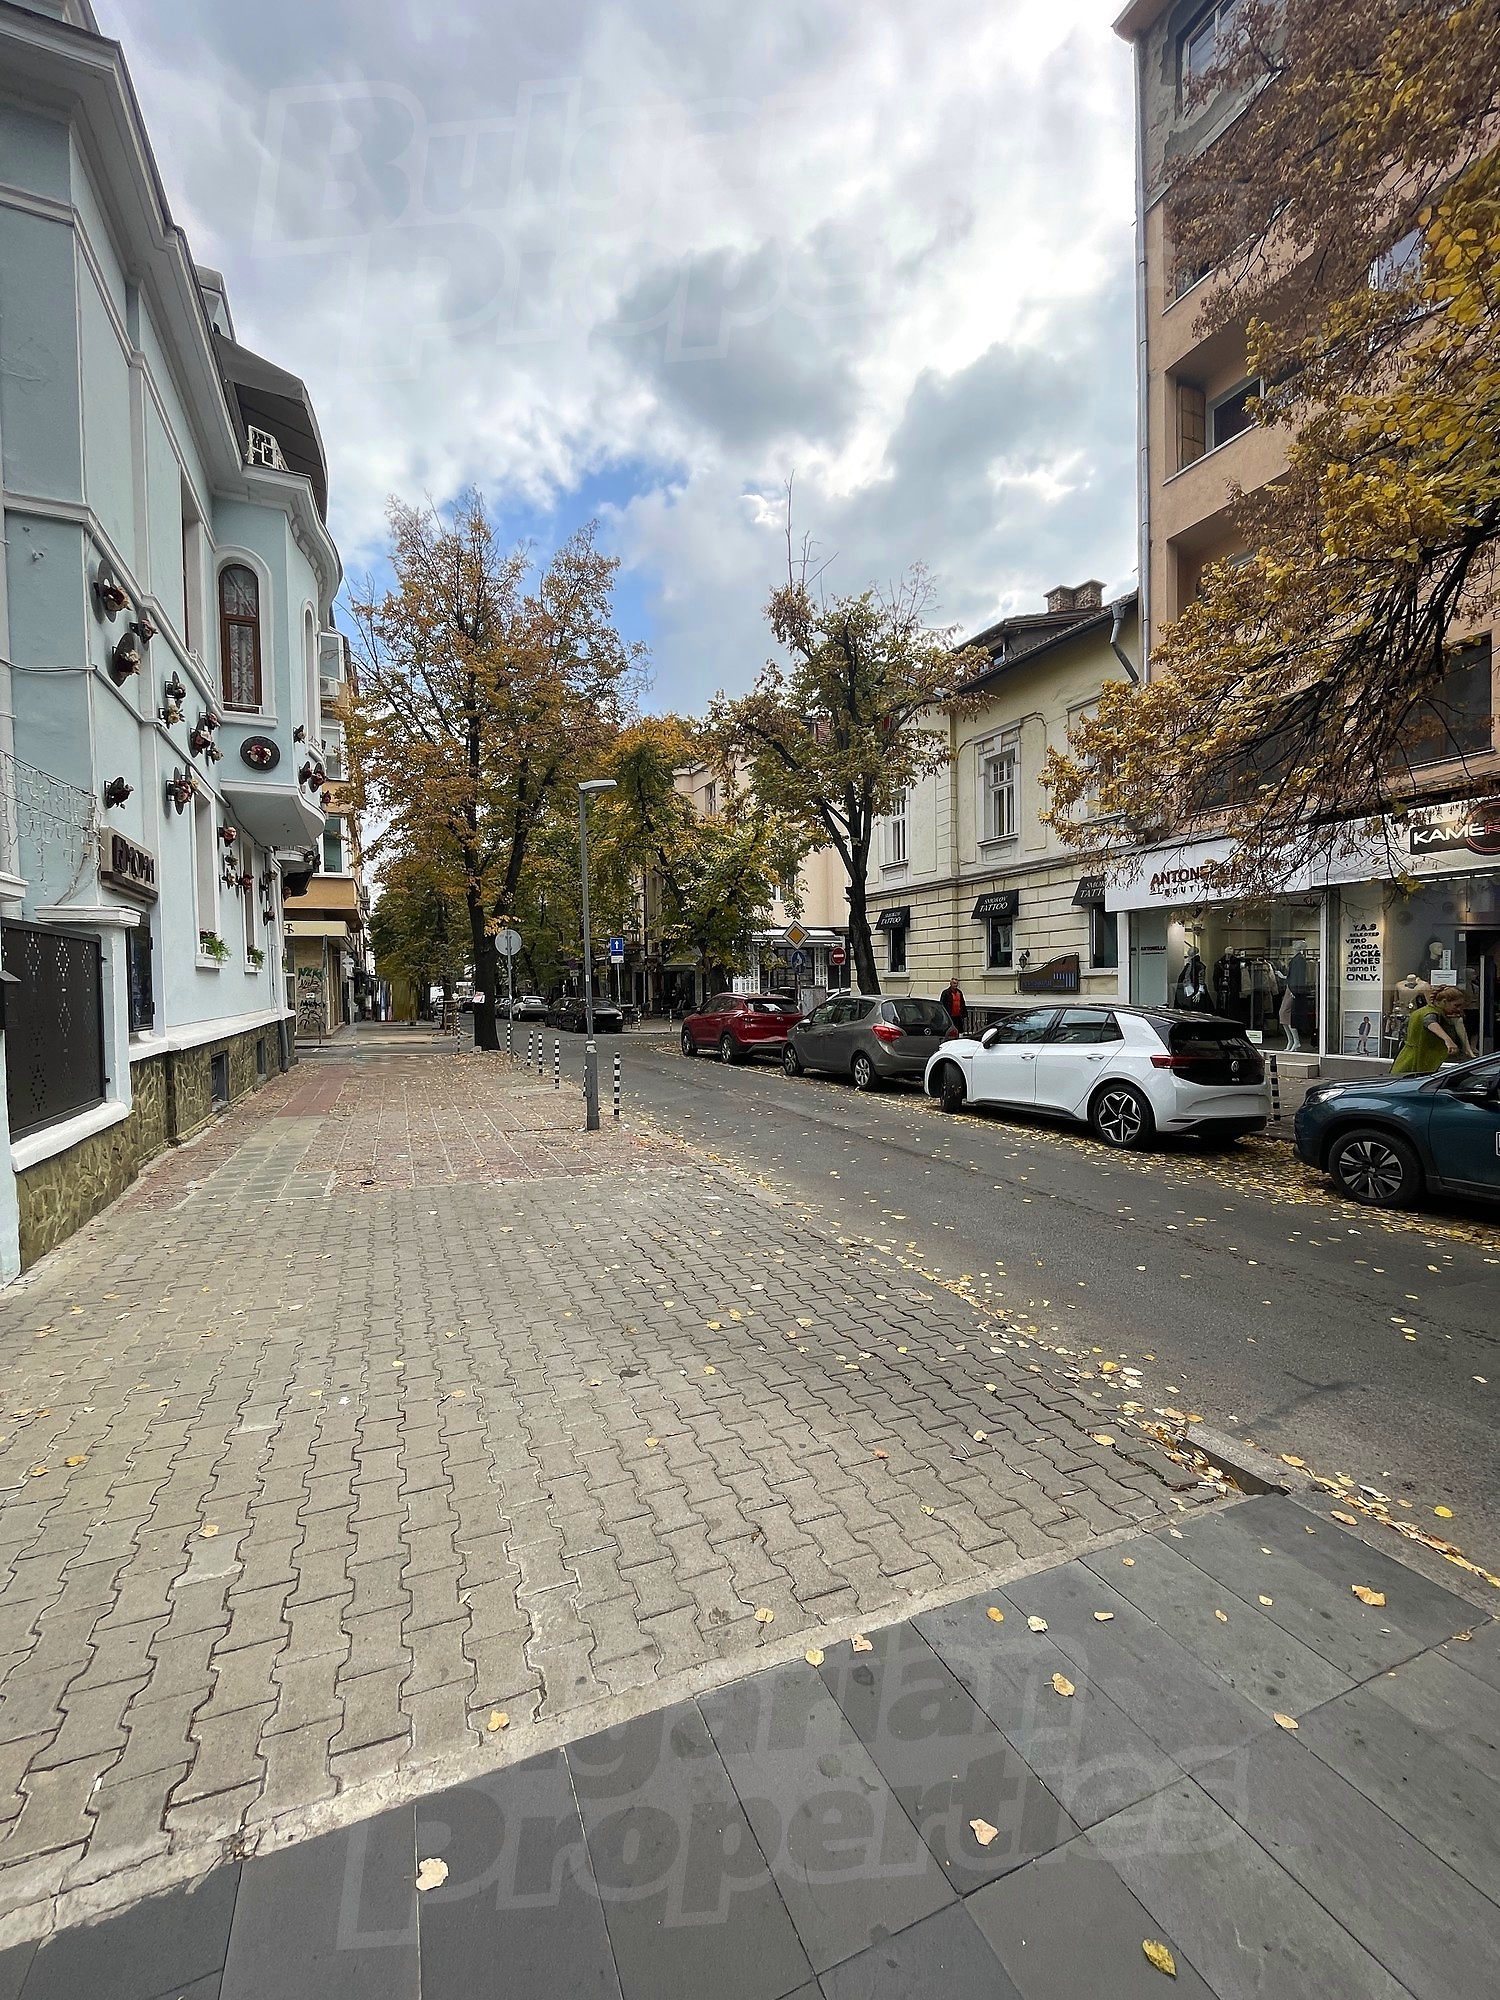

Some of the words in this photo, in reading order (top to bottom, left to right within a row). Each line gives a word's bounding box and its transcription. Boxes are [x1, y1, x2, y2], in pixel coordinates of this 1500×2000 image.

[1080, 888, 1105, 898] TATT
[980, 902, 1008, 912] TATTOO
[1347, 957, 1380, 965] JONES
